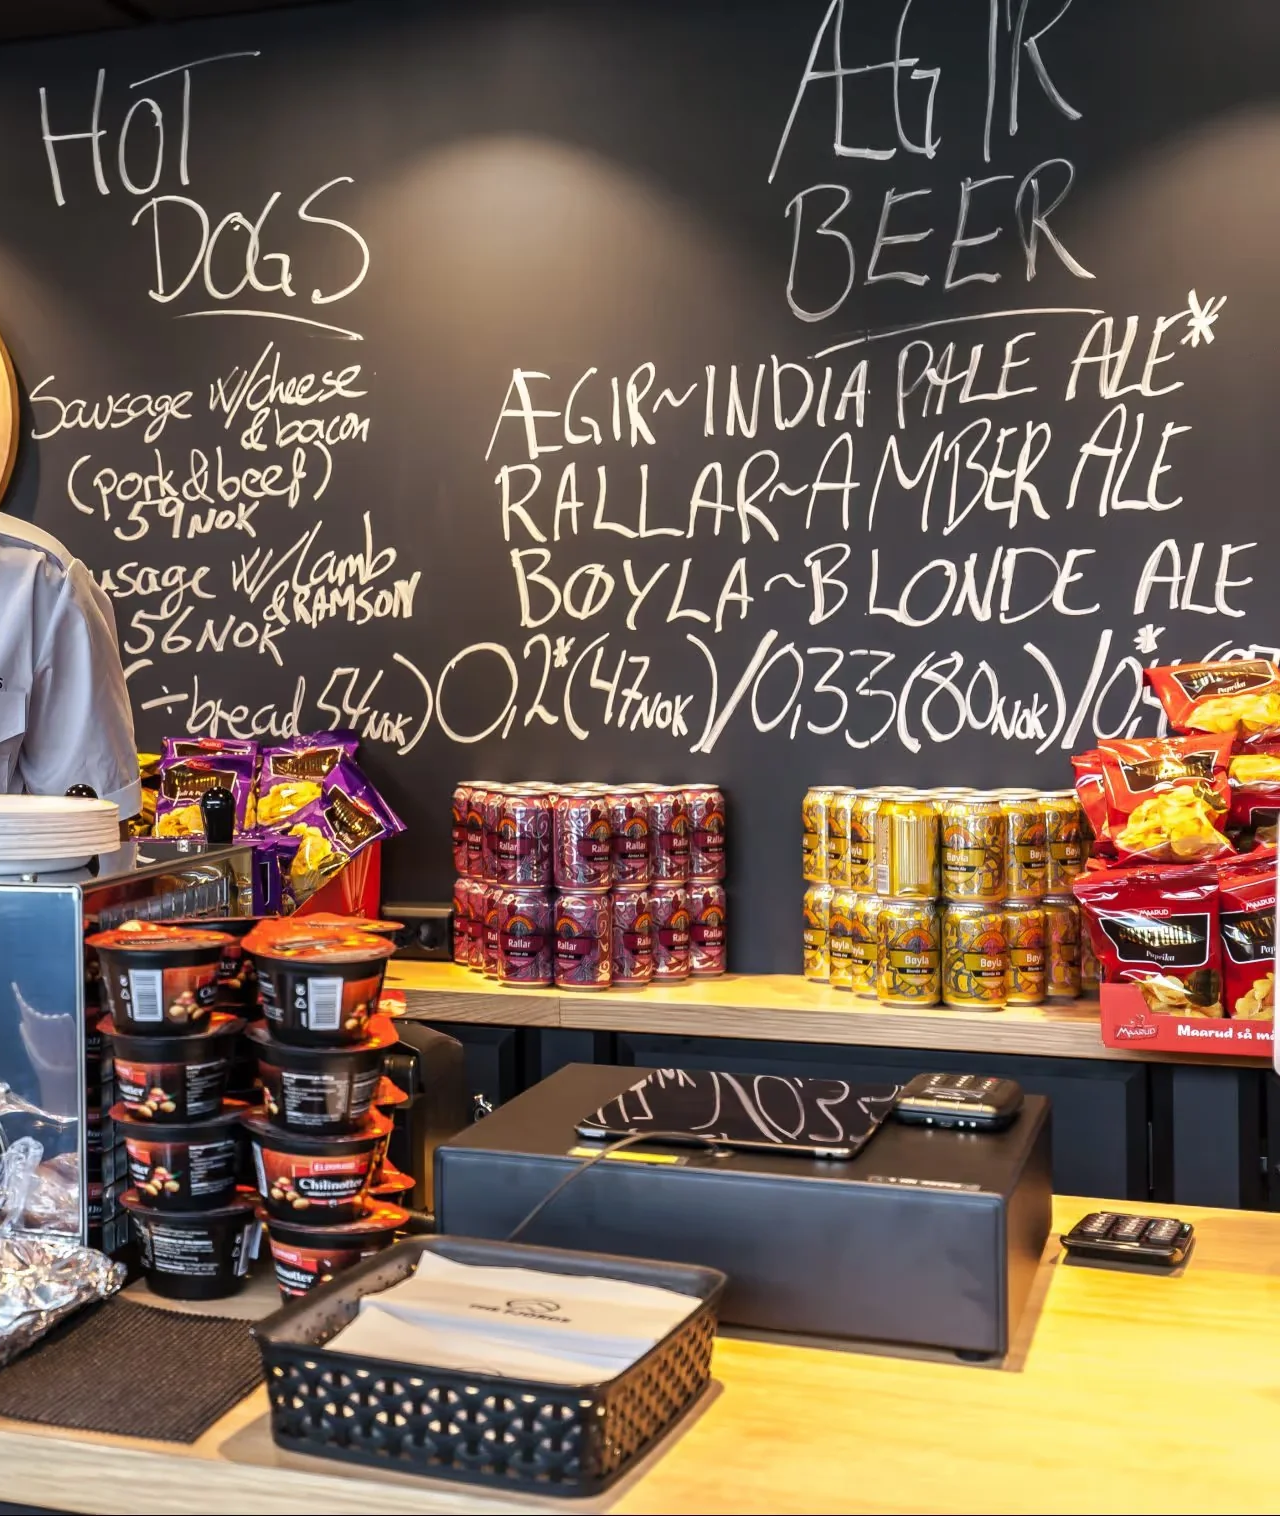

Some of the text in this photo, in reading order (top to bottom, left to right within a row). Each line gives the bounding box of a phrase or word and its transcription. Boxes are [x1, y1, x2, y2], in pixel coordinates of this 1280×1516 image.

[39, 50, 260, 206] HOT
[131, 176, 370, 304] DOGS
[785, 158, 1096, 322] BEER
[897, 340, 1037, 429] PALE
[29, 375, 194, 443] Sausage
[1067, 404, 1192, 517] ALE
[89, 562, 217, 620] usage
[1133, 539, 1257, 617] ALE
[1218, 681, 1246, 694] Paprika
[1138, 908, 1169, 918] MAARUD
[1246, 896, 1276, 911] MAARUD
[508, 938, 531, 949] Rallar
[557, 940, 577, 951] Rallar
[1146, 951, 1175, 962] Paprika
[1116, 1026, 1156, 1038] MAARUD
[1177, 1024, 1233, 1039] Maarud
[1237, 1028, 1253, 1040] så
